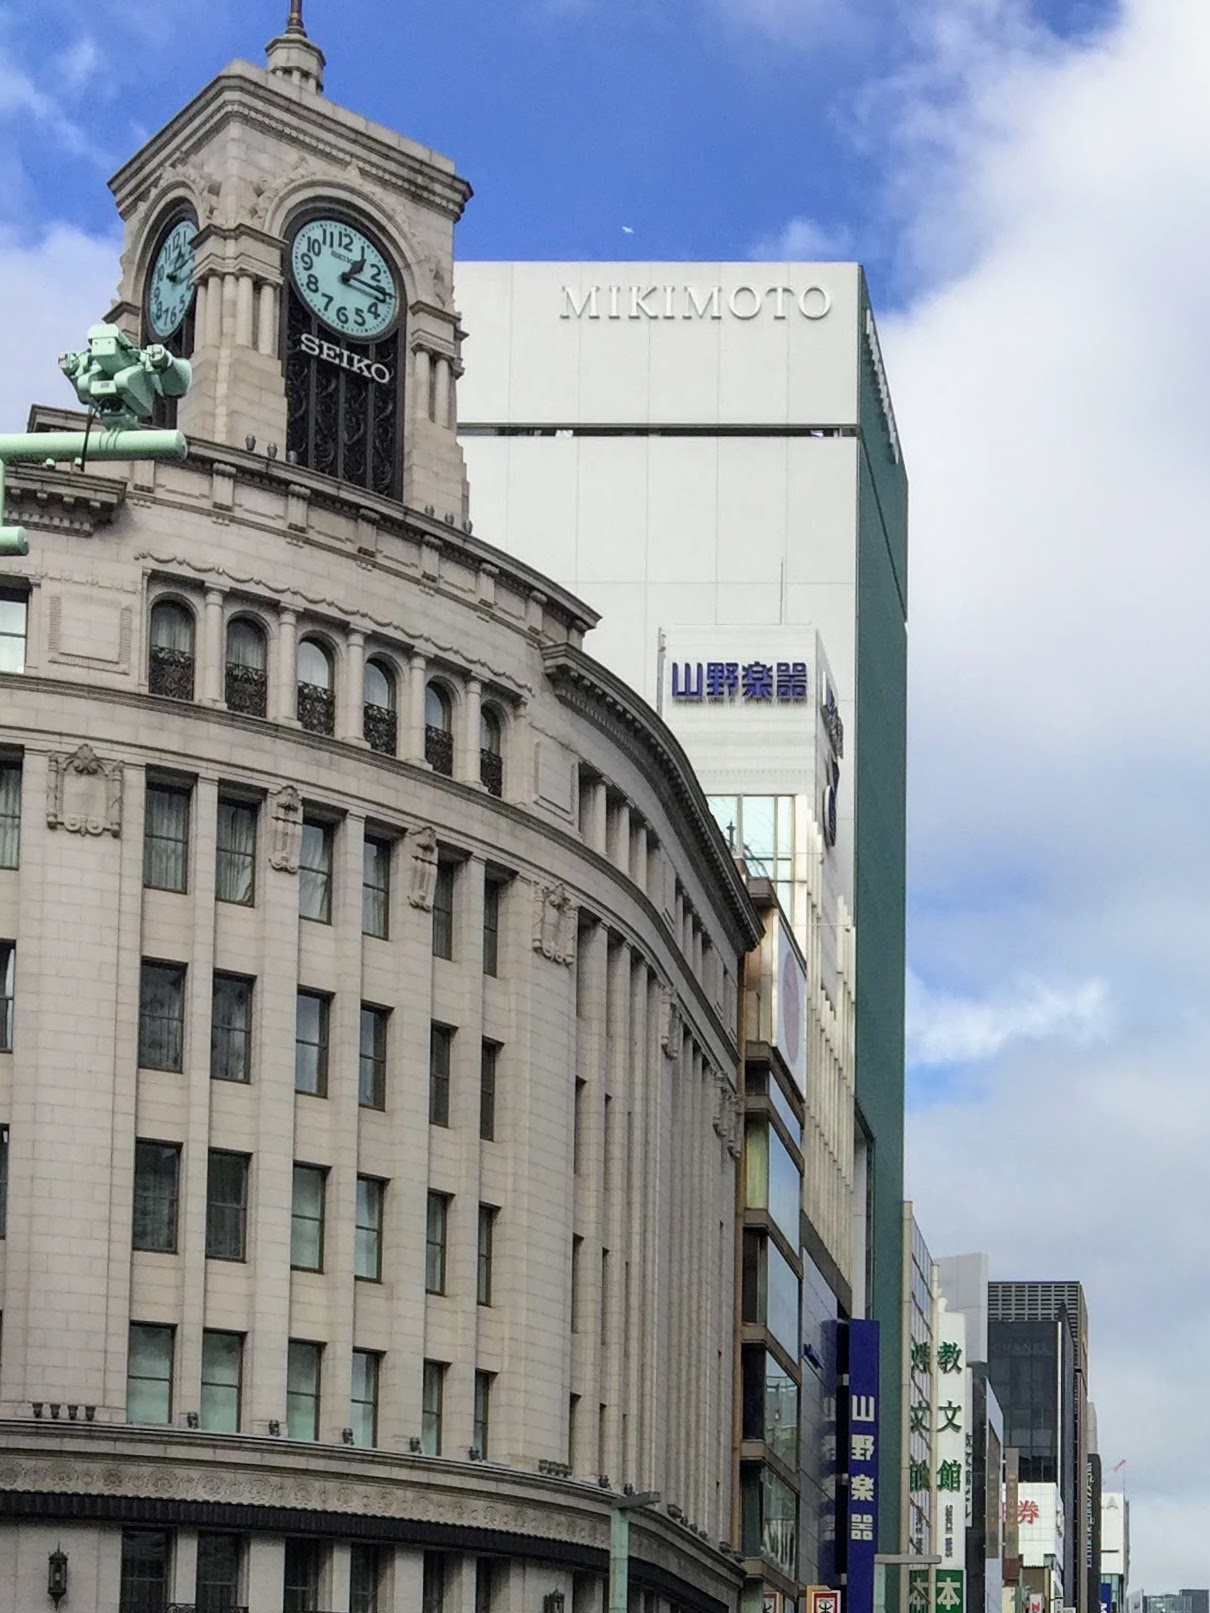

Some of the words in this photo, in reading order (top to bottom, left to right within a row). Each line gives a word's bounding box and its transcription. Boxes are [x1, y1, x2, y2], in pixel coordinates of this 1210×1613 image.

[307, 236, 322, 257] 10
[322, 228, 334, 249] 11
[338, 231, 354, 253] 12
[300, 252, 314, 272] 9
[306, 273, 319, 294] 8
[370, 263, 382, 284] 2
[321, 292, 334, 312] 7
[367, 302, 381, 320] 4
[560, 285, 831, 321] MIKIMOTO
[336, 306, 349, 324] 6
[354, 307, 366, 327] 5
[300, 333, 391, 384] SEIKO
[671, 661, 807, 698] 山野楽器
[936, 1341, 962, 1492] 教文館
[851, 1395, 875, 1541] 山野楽器
[937, 1577, 961, 1611] 本
